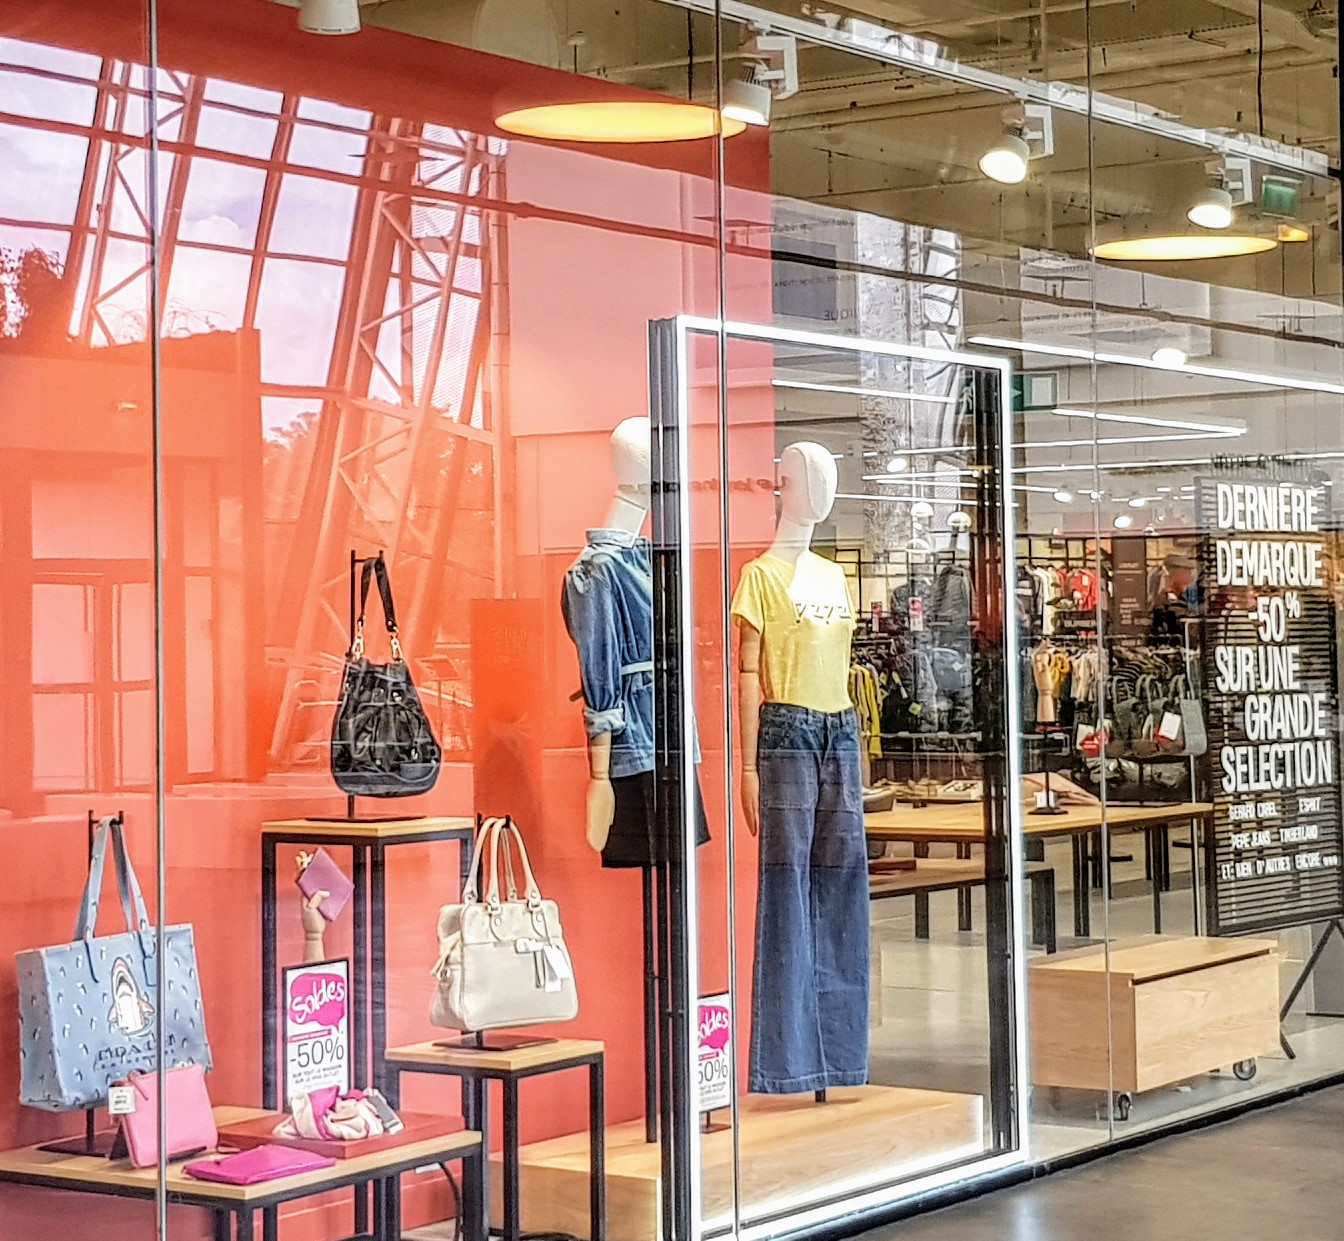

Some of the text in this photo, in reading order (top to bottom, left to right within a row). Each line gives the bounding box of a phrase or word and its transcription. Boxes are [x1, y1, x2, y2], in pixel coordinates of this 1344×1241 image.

[1216, 540, 1324, 587] DEMARQUE
[1248, 591, 1301, 642] -50%
[1215, 644, 1302, 694] SUR UNE
[1244, 692, 1327, 742] GRANDE
[1220, 739, 1333, 793] SELECTION
[291, 978, 346, 1023] Soldes
[698, 1010, 729, 1039] oldes
[289, 1036, 345, 1068] -50%
